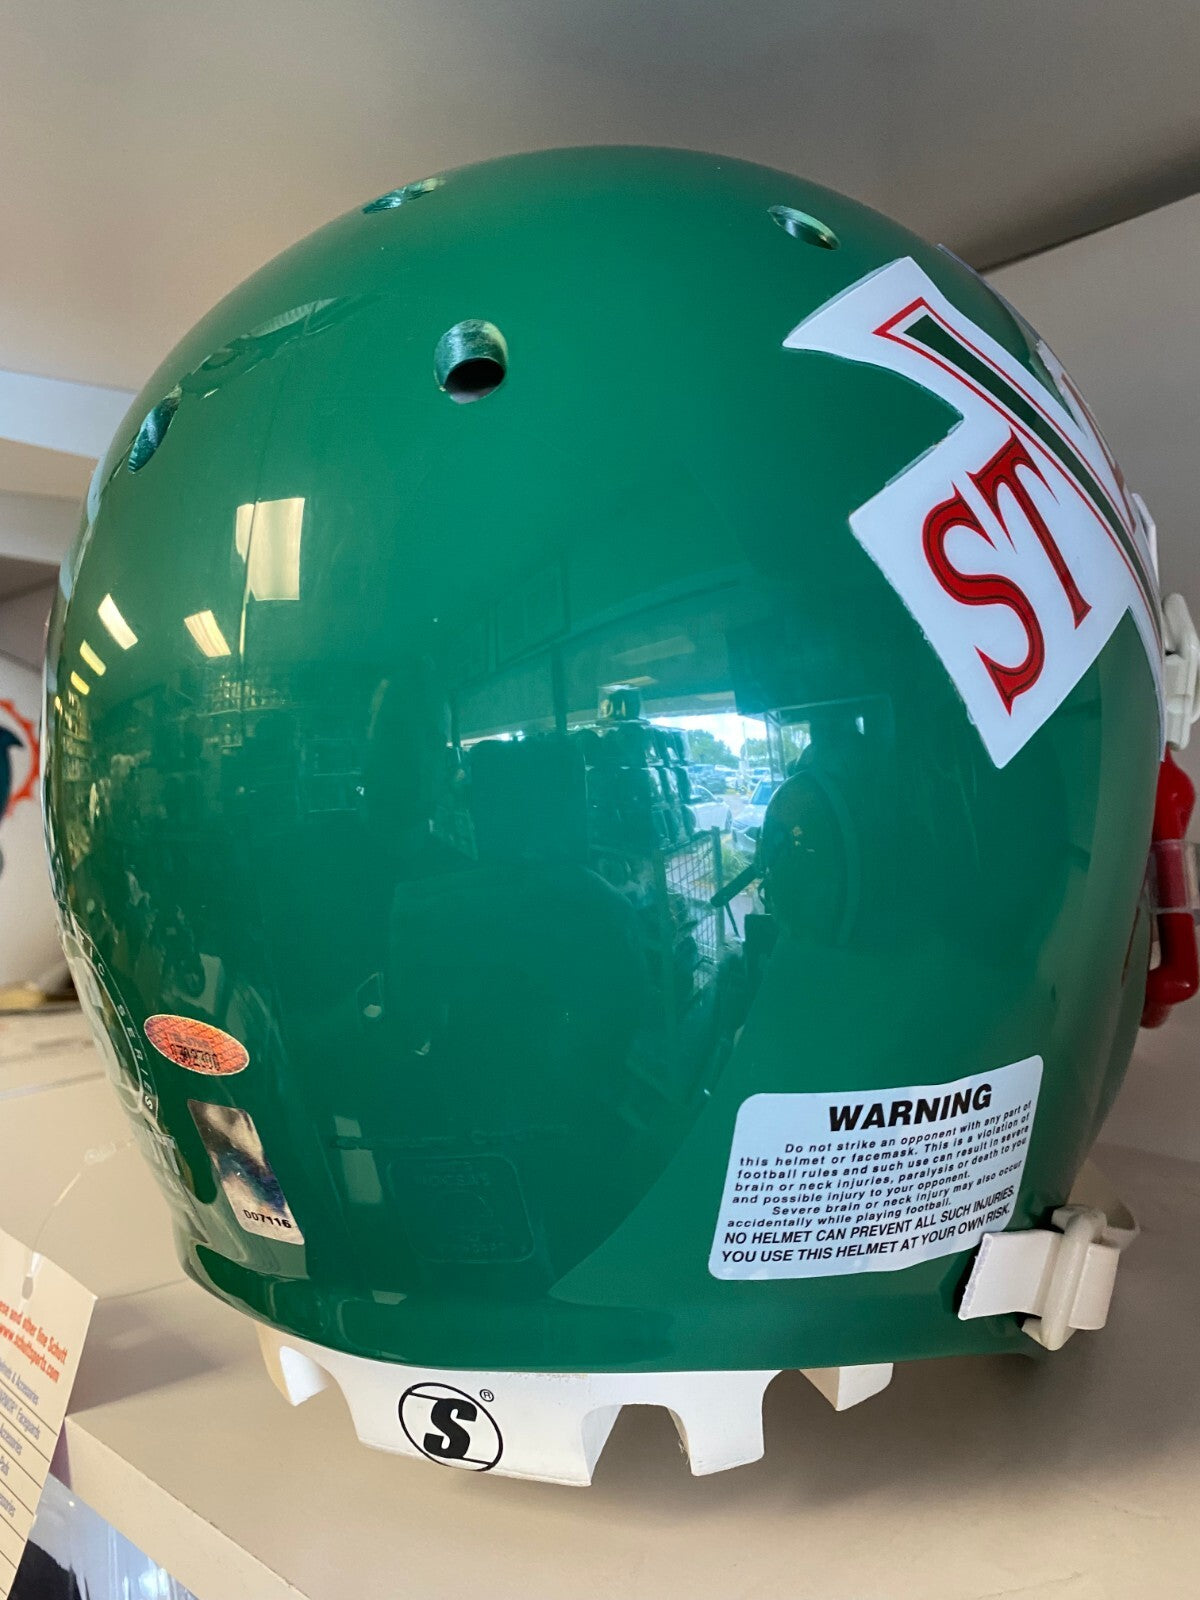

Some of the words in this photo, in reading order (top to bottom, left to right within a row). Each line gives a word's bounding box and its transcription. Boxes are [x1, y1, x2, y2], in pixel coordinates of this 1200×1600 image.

[785, 1143, 804, 1152] Do
[809, 1142, 832, 1151] not
[837, 1139, 875, 1151] strike
[881, 1138, 895, 1147] an
[901, 1127, 956, 1145] opponent
[960, 1122, 981, 1133] with
[984, 1115, 1001, 1130] any
[1003, 1105, 1021, 1122] part
[1023, 1100, 1031, 1111] of
[829, 1084, 992, 1131] WARNING
[735, 1182, 773, 1192] brain
[800, 1180, 832, 1190] neck
[837, 1175, 894, 1190] injuries,
[899, 1164, 954, 1184] paralysis
[958, 1160, 969, 1169] or
[972, 1149, 998, 1166] death
[1001, 1145, 1009, 1155] to
[1012, 1138, 1026, 1152] you
[737, 1169, 796, 1179] football
[801, 1167, 837, 1177] rules
[843, 1165, 867, 1175] and
[873, 1160, 902, 1172] such
[908, 1157, 928, 1166] use
[932, 1152, 952, 1163] can
[956, 1141, 987, 1158] result
[990, 1137, 998, 1148] in
[1001, 1125, 1028, 1143] severe
[740, 1157, 768, 1166] this
[776, 1155, 824, 1166] helmet
[832, 1155, 845, 1163] or
[851, 1147, 918, 1162] facemask.
[924, 1140, 948, 1152] This
[953, 1138, 962, 1146] is
[978, 1120, 1019, 1140] violation
[1021, 1113, 1030, 1124] of
[728, 1217, 812, 1228] accidentally
[817, 1214, 852, 1224] while
[856, 1209, 901, 1224] playing
[906, 1199, 951, 1214] football.
[732, 1195, 757, 1204] and
[763, 1193, 822, 1206] possible
[827, 1189, 864, 1203] injury
[870, 1187, 882, 1196] to
[887, 1185, 914, 1197] your
[918, 1171, 970, 1190] opponent.
[772, 1205, 820, 1215] Severe
[825, 1202, 860, 1213] brain
[865, 1201, 879, 1209] or
[883, 1195, 911, 1208] neck
[916, 1188, 950, 1206] injury
[953, 1181, 974, 1195] may
[977, 1172, 996, 1186] also
[999, 1160, 1022, 1177] occur
[243, 1209, 292, 1229] 007116
[722, 1250, 757, 1262] YOU
[760, 1249, 793, 1262] USE
[798, 1247, 832, 1261] THIS
[836, 1240, 896, 1258] HELMET
[900, 1236, 918, 1251] AT
[922, 1226, 954, 1246] YOUR
[958, 1216, 984, 1234] OWN
[986, 1205, 1010, 1224] RISK.
[724, 1232, 746, 1245] NO
[751, 1231, 812, 1244] HELMET
[816, 1227, 846, 1241] CAN
[850, 1220, 912, 1239] PREVENT
[915, 1213, 937, 1229] ALL
[941, 1204, 970, 1221] SUCH
[973, 1185, 1014, 1213] INJURIES.
